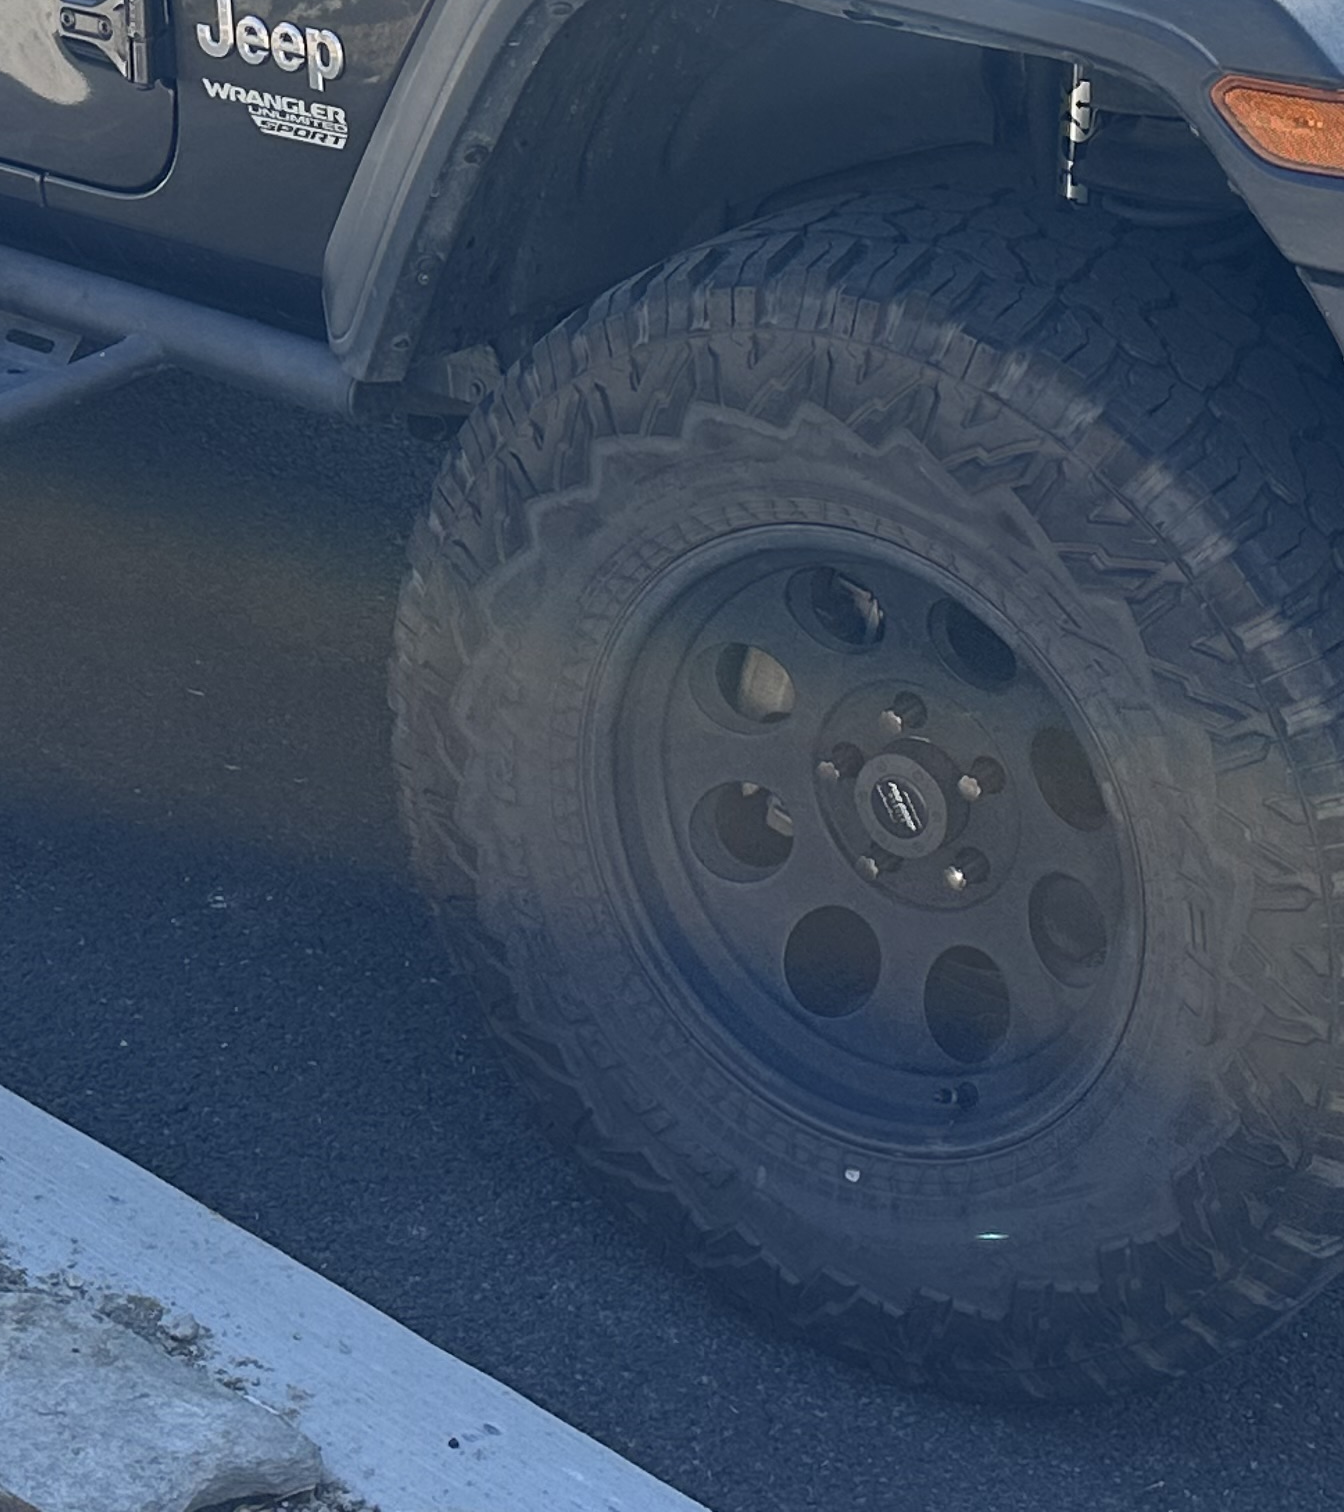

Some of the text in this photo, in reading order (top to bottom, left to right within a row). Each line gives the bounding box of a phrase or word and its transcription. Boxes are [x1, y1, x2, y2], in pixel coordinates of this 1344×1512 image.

[202, 77, 347, 125] WRANGLER
[247, 104, 348, 133] UNLIMITED
[258, 119, 346, 146] SPORT
